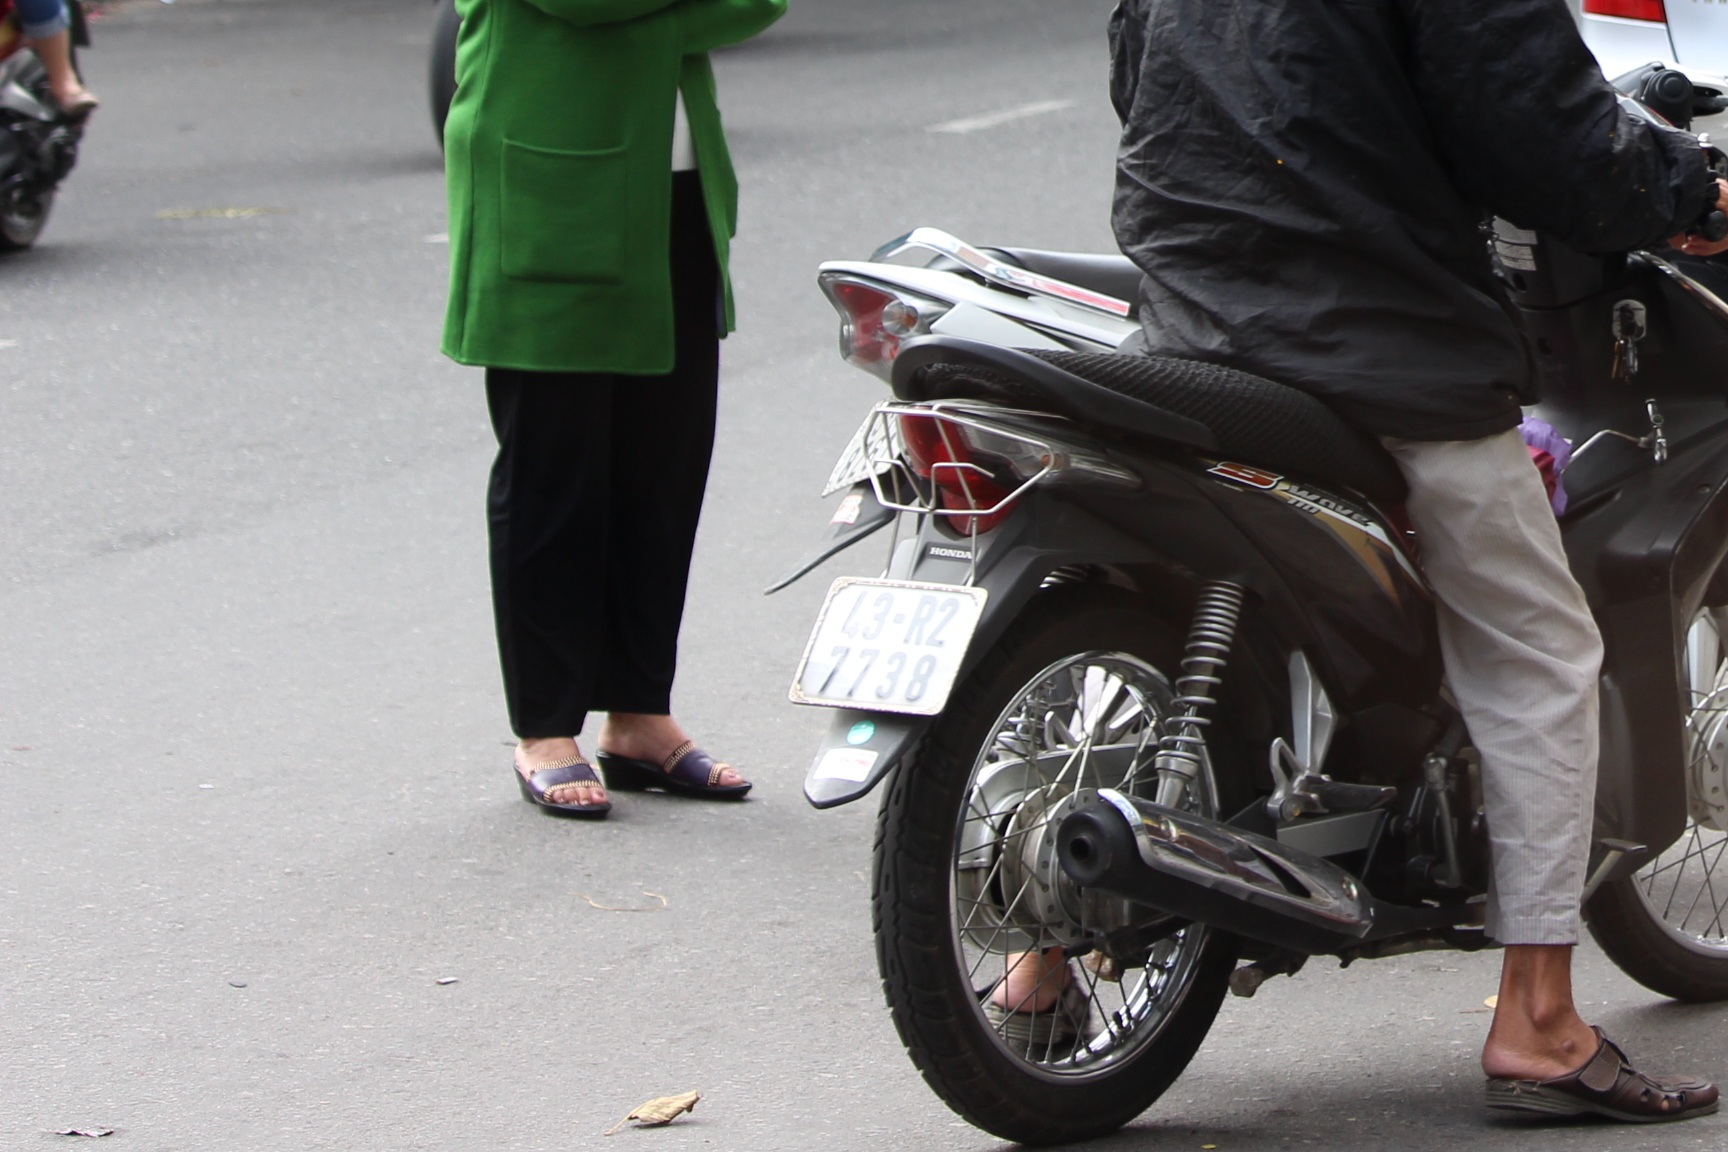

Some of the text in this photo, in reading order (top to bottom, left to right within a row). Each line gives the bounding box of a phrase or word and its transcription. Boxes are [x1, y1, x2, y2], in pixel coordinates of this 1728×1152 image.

[929, 547, 974, 559] HONDA
[840, 590, 960, 648] 43-R2
[818, 645, 938, 702] 7738
